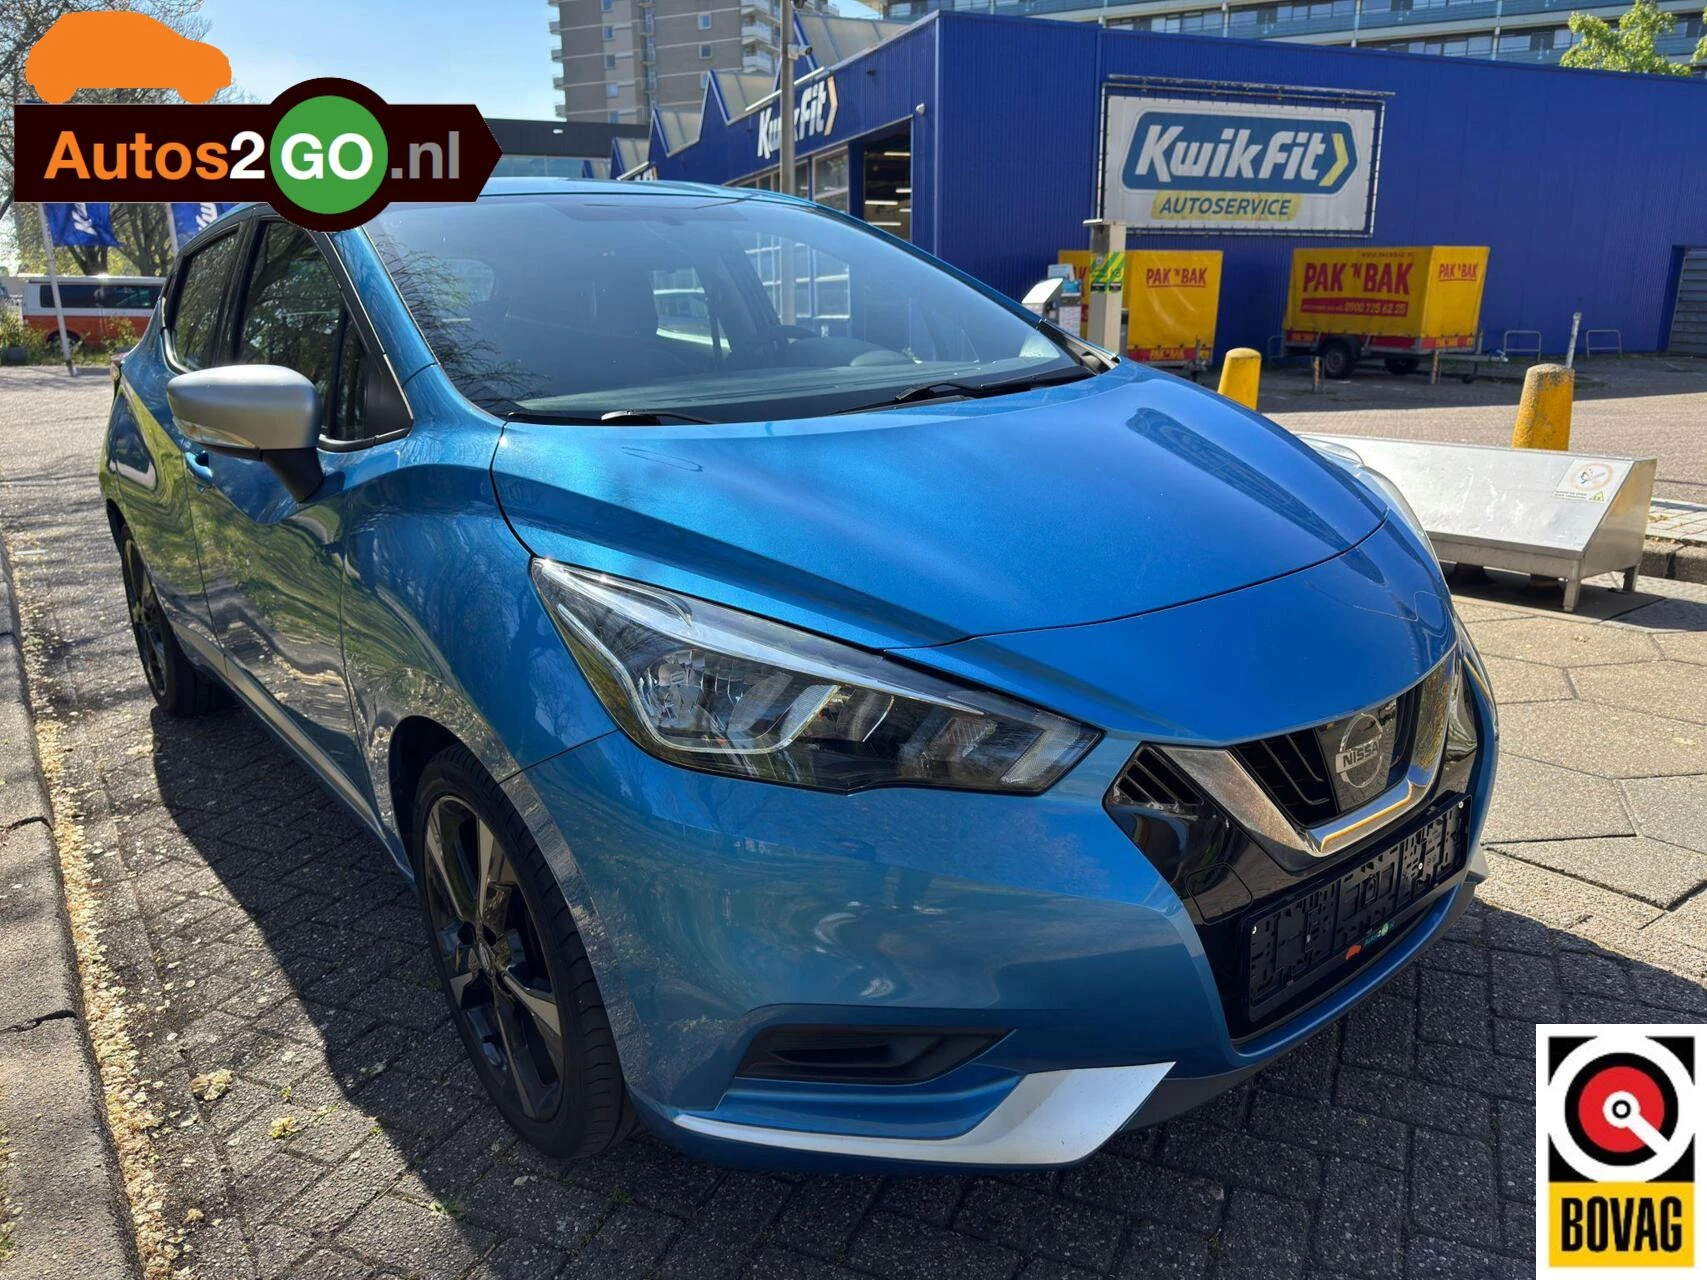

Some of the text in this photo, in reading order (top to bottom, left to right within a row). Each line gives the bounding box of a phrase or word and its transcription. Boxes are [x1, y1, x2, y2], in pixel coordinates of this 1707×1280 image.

[757, 80, 827, 160] KwkFit
[1160, 197, 1292, 216] AUTOSERVICE
[1146, 268, 1171, 285] PAK
[1181, 267, 1208, 285] BAK
[1303, 262, 1347, 292] PAK
[1363, 262, 1414, 295] BAK
[1439, 263, 1456, 279] PAK
[1461, 262, 1479, 278] BAK
